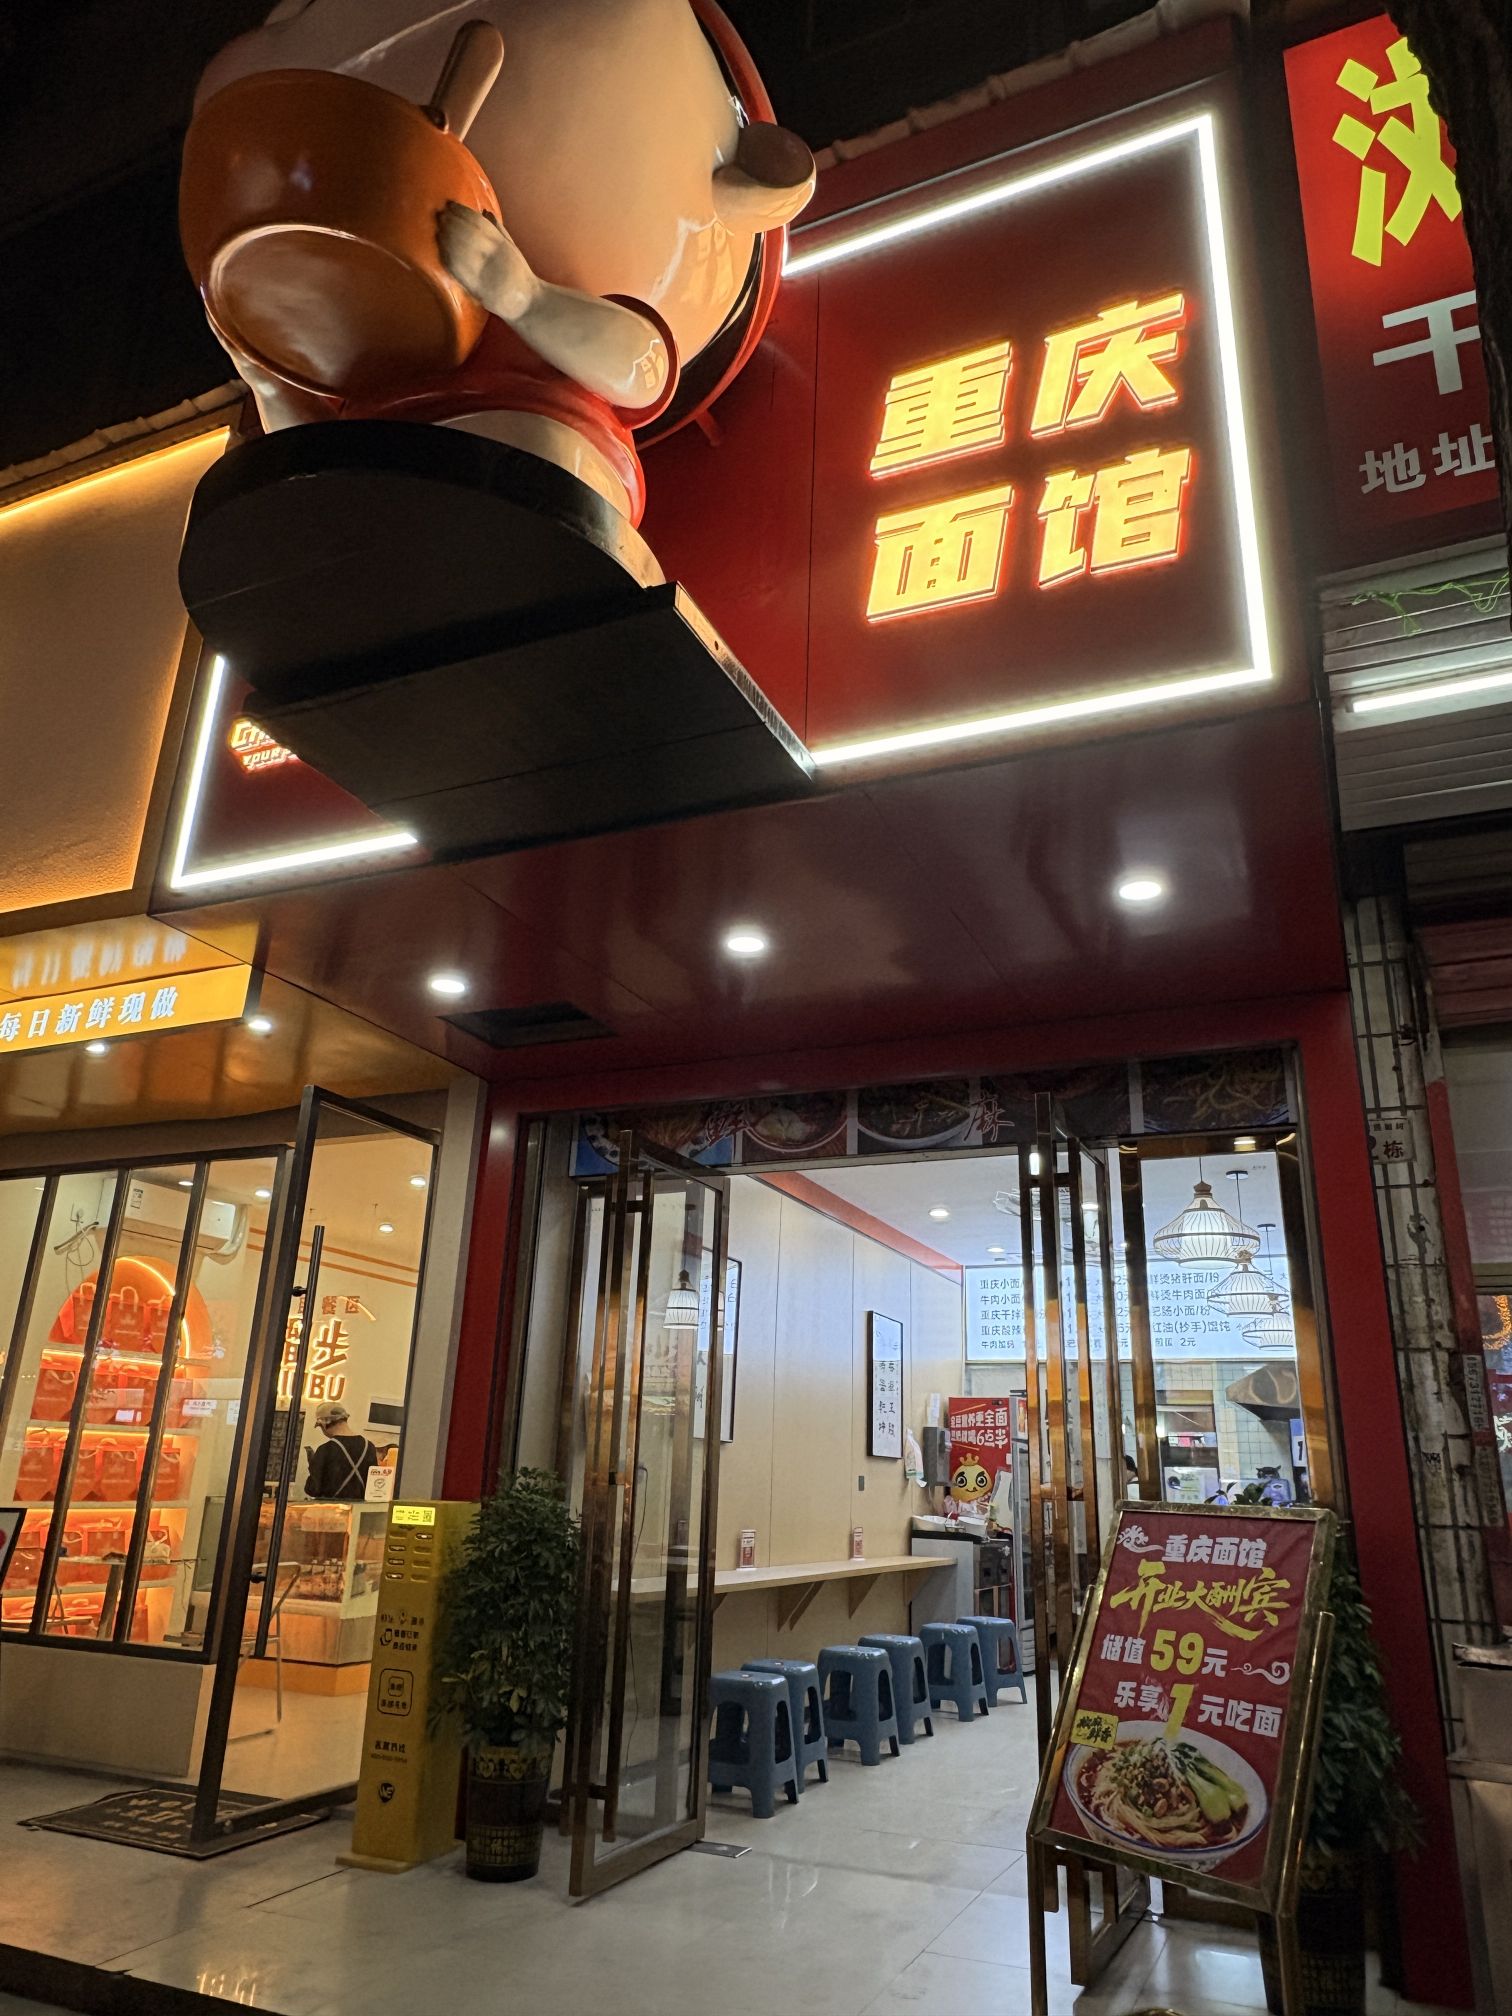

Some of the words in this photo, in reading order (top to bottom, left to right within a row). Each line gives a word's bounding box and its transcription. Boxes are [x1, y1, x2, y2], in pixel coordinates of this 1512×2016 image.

[869, 291, 1186, 479] 重庆
[1358, 423, 1497, 494] 地址
[865, 446, 1192, 622] 面馆
[0, 986, 178, 1041] 每日新鲜现做
[1161, 1533, 1268, 1568] 重庆面馆
[1109, 1558, 1291, 1641] 开业大酬宾
[1100, 1629, 1228, 1678] 储值59元
